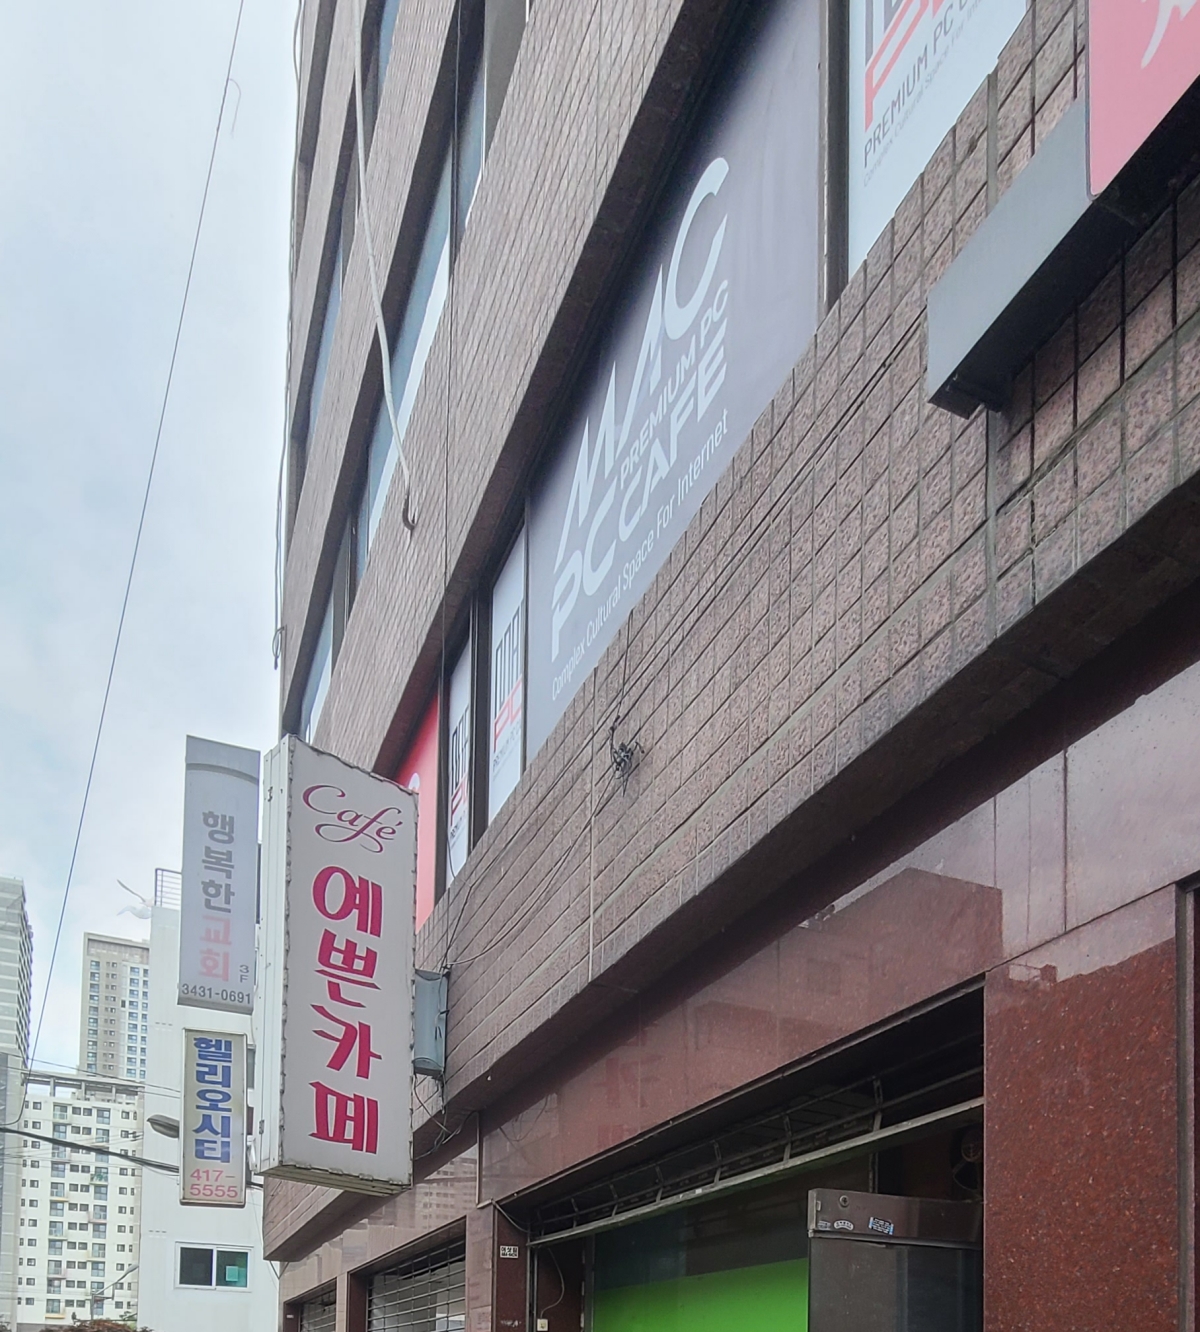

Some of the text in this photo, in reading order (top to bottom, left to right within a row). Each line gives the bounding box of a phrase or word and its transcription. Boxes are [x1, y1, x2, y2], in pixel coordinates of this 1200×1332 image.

[863, 42, 928, 168] PREMIUM
[933, 3, 955, 55] PC
[554, 157, 729, 573] MAC
[620, 279, 728, 490] PREMIUM PC
[552, 317, 728, 662] PC CAFE
[552, 408, 728, 701] Complex Cultural Space For Internet
[302, 784, 403, 854] Café
[181, 983, 252, 1005] 3431-0691
[308, 865, 383, 1155] 예쁜카페
[189, 1183, 238, 1198] 5555
[193, 1036, 233, 1164] 헬리오시티
